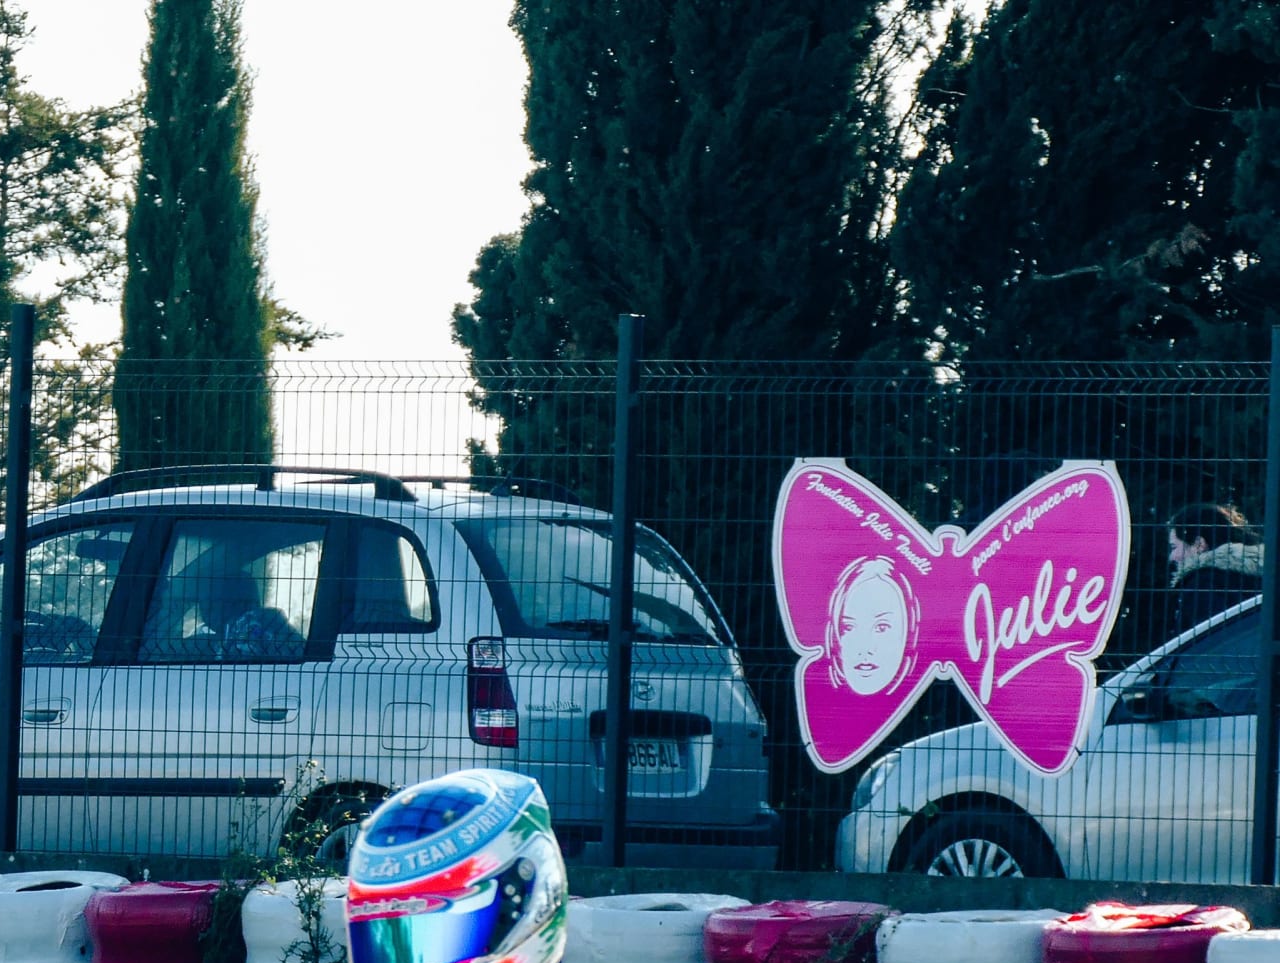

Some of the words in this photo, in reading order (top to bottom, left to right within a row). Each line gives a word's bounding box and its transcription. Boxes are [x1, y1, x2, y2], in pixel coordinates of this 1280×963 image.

[860, 512, 894, 541] Julie
[972, 539, 1002, 577] pour
[964, 559, 1108, 704] Julie
[405, 838, 458, 870] TEAM
